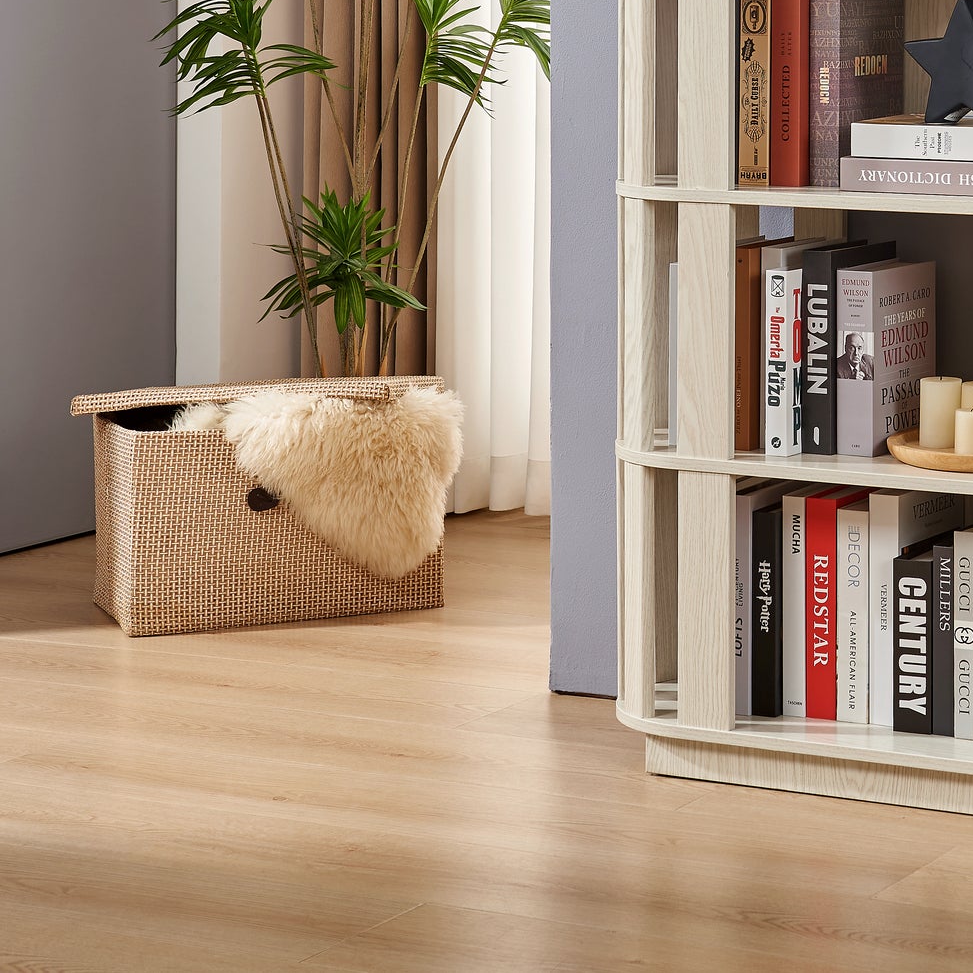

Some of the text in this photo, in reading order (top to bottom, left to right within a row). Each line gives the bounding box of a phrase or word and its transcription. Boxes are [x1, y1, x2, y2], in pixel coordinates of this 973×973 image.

[819, 67, 829, 104] REDOCN
[854, 54, 888, 77] REDOCN
[750, 77, 758, 125] DAILY CURSE
[781, 65, 790, 142] COLLECTED
[858, 169, 951, 185] DICTIONARY
[879, 287, 931, 307] ROBERT A. CARO
[884, 307, 926, 326] THE YEARS OF
[770, 316, 784, 358] Omerta
[807, 283, 828, 395] LUBALIN
[881, 321, 929, 348] EDMUND
[883, 340, 927, 367] WILSON
[768, 360, 786, 407] Puzo
[881, 379, 920, 405] PASSAG
[899, 368, 910, 378] THE
[885, 408, 920, 433] POWE
[913, 493, 955, 519] VERMEER
[792, 514, 800, 554] MUCHA
[848, 531, 860, 588] DECOR
[756, 560, 772, 632] Harry Potter
[939, 557, 950, 631] MILLERS
[958, 557, 970, 612] GUCCI
[813, 554, 829, 667] REDSTAR
[848, 610, 857, 710] ALL-AMERICAN FLAIR
[898, 577, 927, 716] CENTURY
[958, 659, 970, 715] GUCCI
